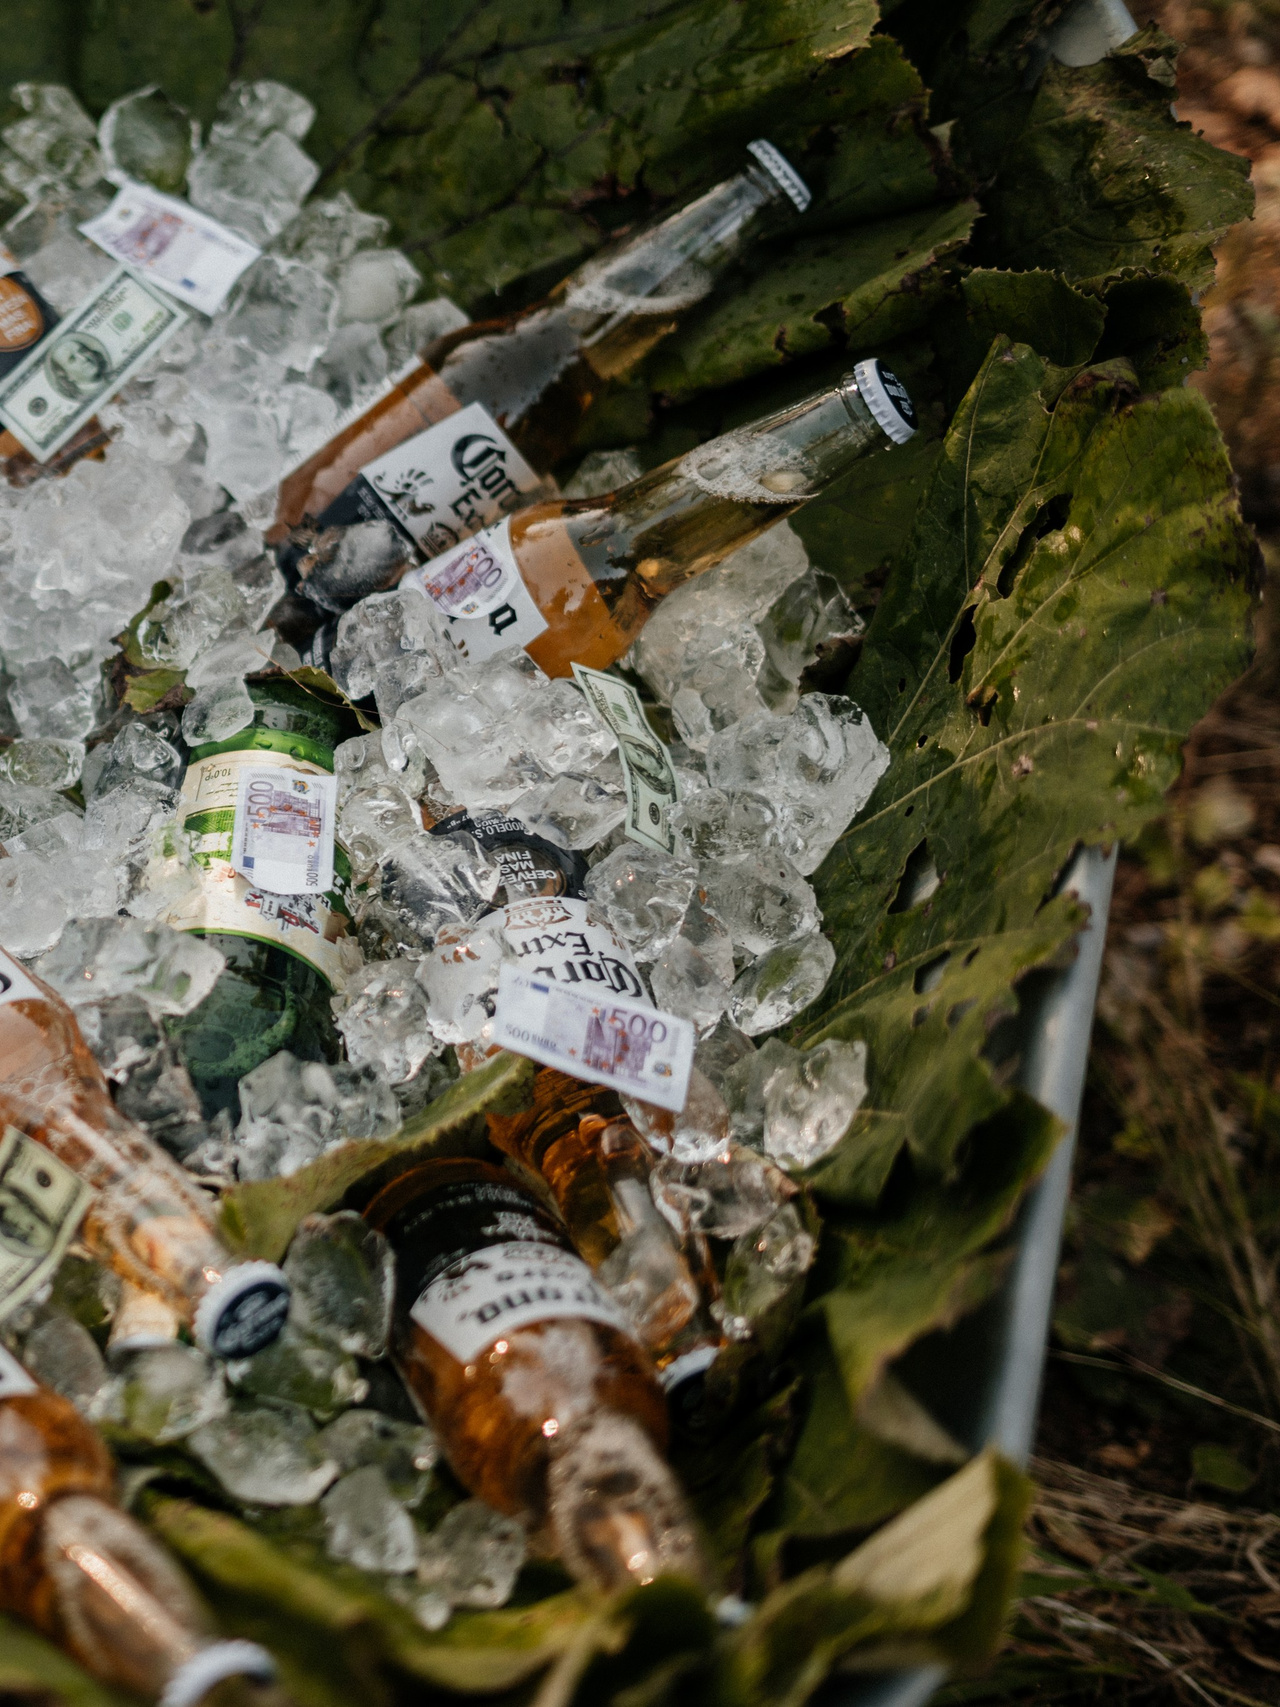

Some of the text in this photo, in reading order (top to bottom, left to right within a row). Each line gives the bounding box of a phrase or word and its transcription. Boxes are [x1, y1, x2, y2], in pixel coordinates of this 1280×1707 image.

[247, 781, 275, 816] 500
[494, 850, 531, 864] FINA
[500, 860, 535, 873] MAS
[306, 854, 319, 887] 500 EURO
[498, 869, 557, 887] CERVEZ
[517, 881, 538, 891] LA
[517, 931, 595, 957] Extr
[533, 952, 644, 998] Cor
[505, 1023, 531, 1042] 500
[610, 1007, 668, 1044] 500
